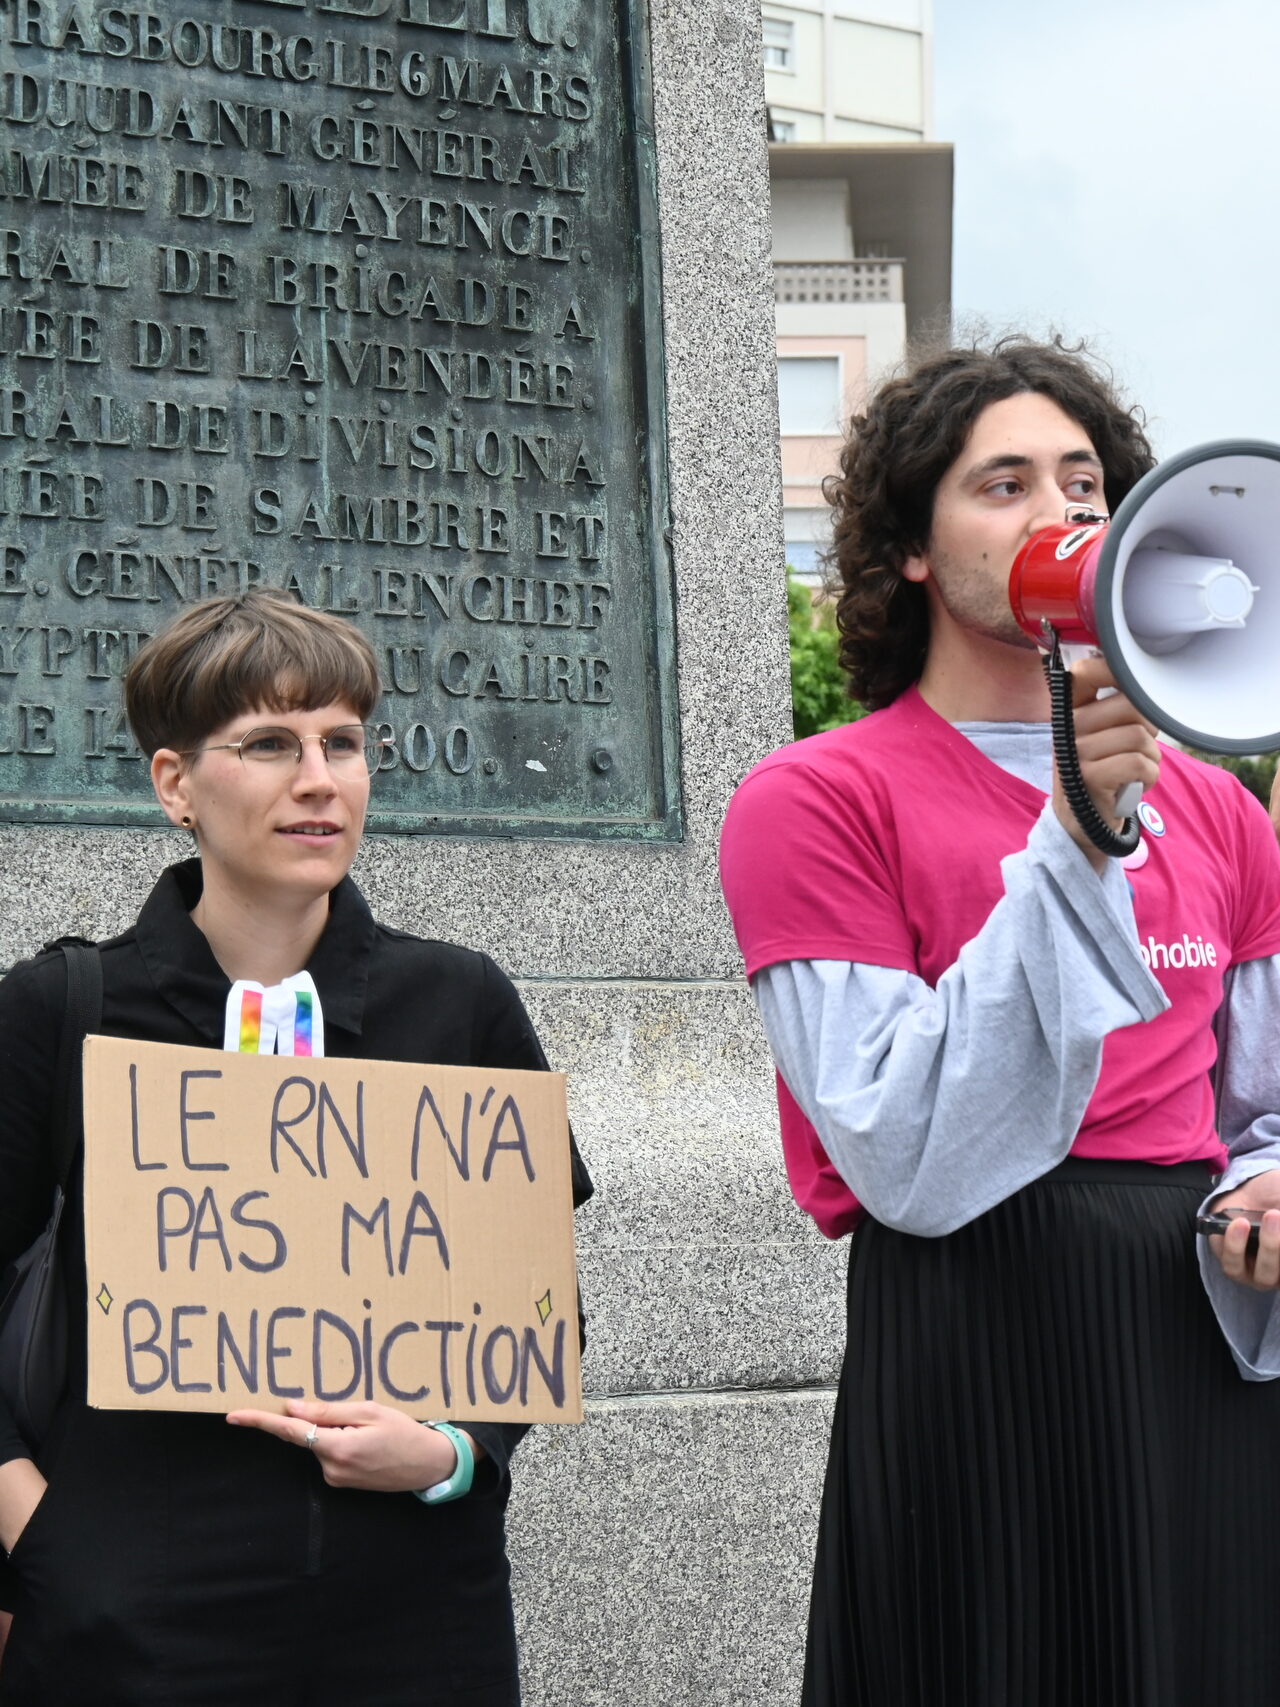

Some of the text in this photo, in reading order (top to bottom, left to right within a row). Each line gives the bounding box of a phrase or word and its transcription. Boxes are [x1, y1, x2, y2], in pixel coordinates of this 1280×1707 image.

[0, 0, 320, 81] RASBOURG
[437, 56, 592, 121] MARS
[0, 137, 592, 264] MÉE DE MAYENCE.
[0, 229, 129, 289] RAL
[159, 245, 238, 300] DE
[554, 295, 595, 341] A
[0, 283, 595, 410] ÉE DE LA VENDÉE.
[0, 389, 131, 446] RAL
[148, 400, 229, 454] DE
[565, 438, 606, 486] A
[0, 454, 604, 561] ÉE DE SAMBRE ET
[382, 647, 425, 695] U
[440, 634, 613, 704] CAIRE
[0, 704, 55, 756] E
[129, 1063, 535, 1183] LE RN N'A
[156, 1185, 450, 1277] PAS MA
